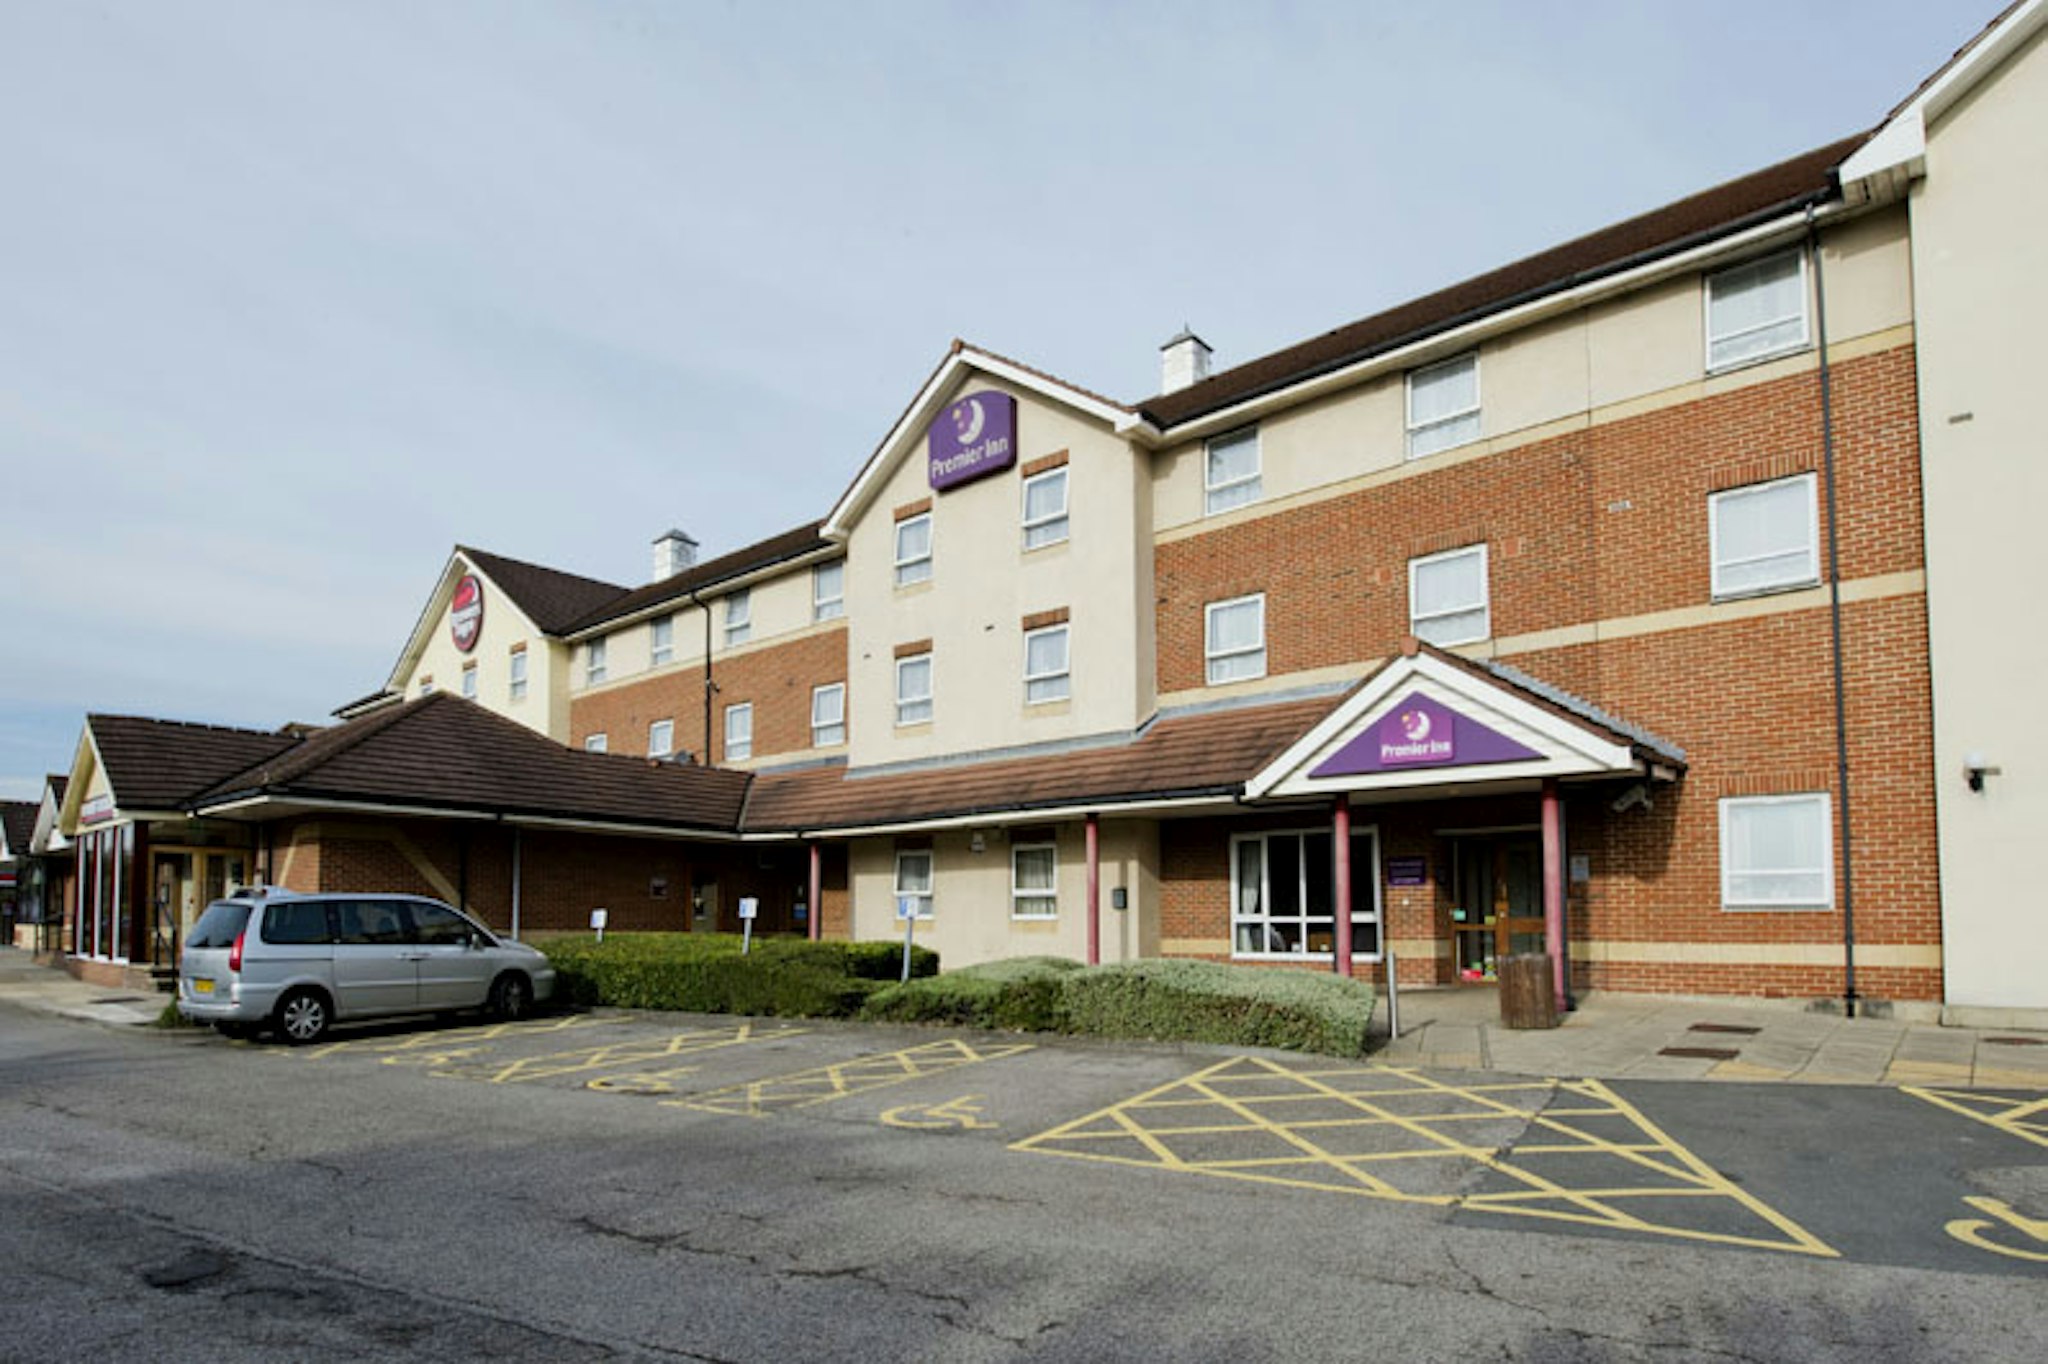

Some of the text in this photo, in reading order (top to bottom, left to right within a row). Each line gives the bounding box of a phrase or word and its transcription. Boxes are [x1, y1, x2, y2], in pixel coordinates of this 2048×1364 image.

[932, 438, 1008, 478] Premier Inn
[1381, 740, 1451, 758] Premier Inn
